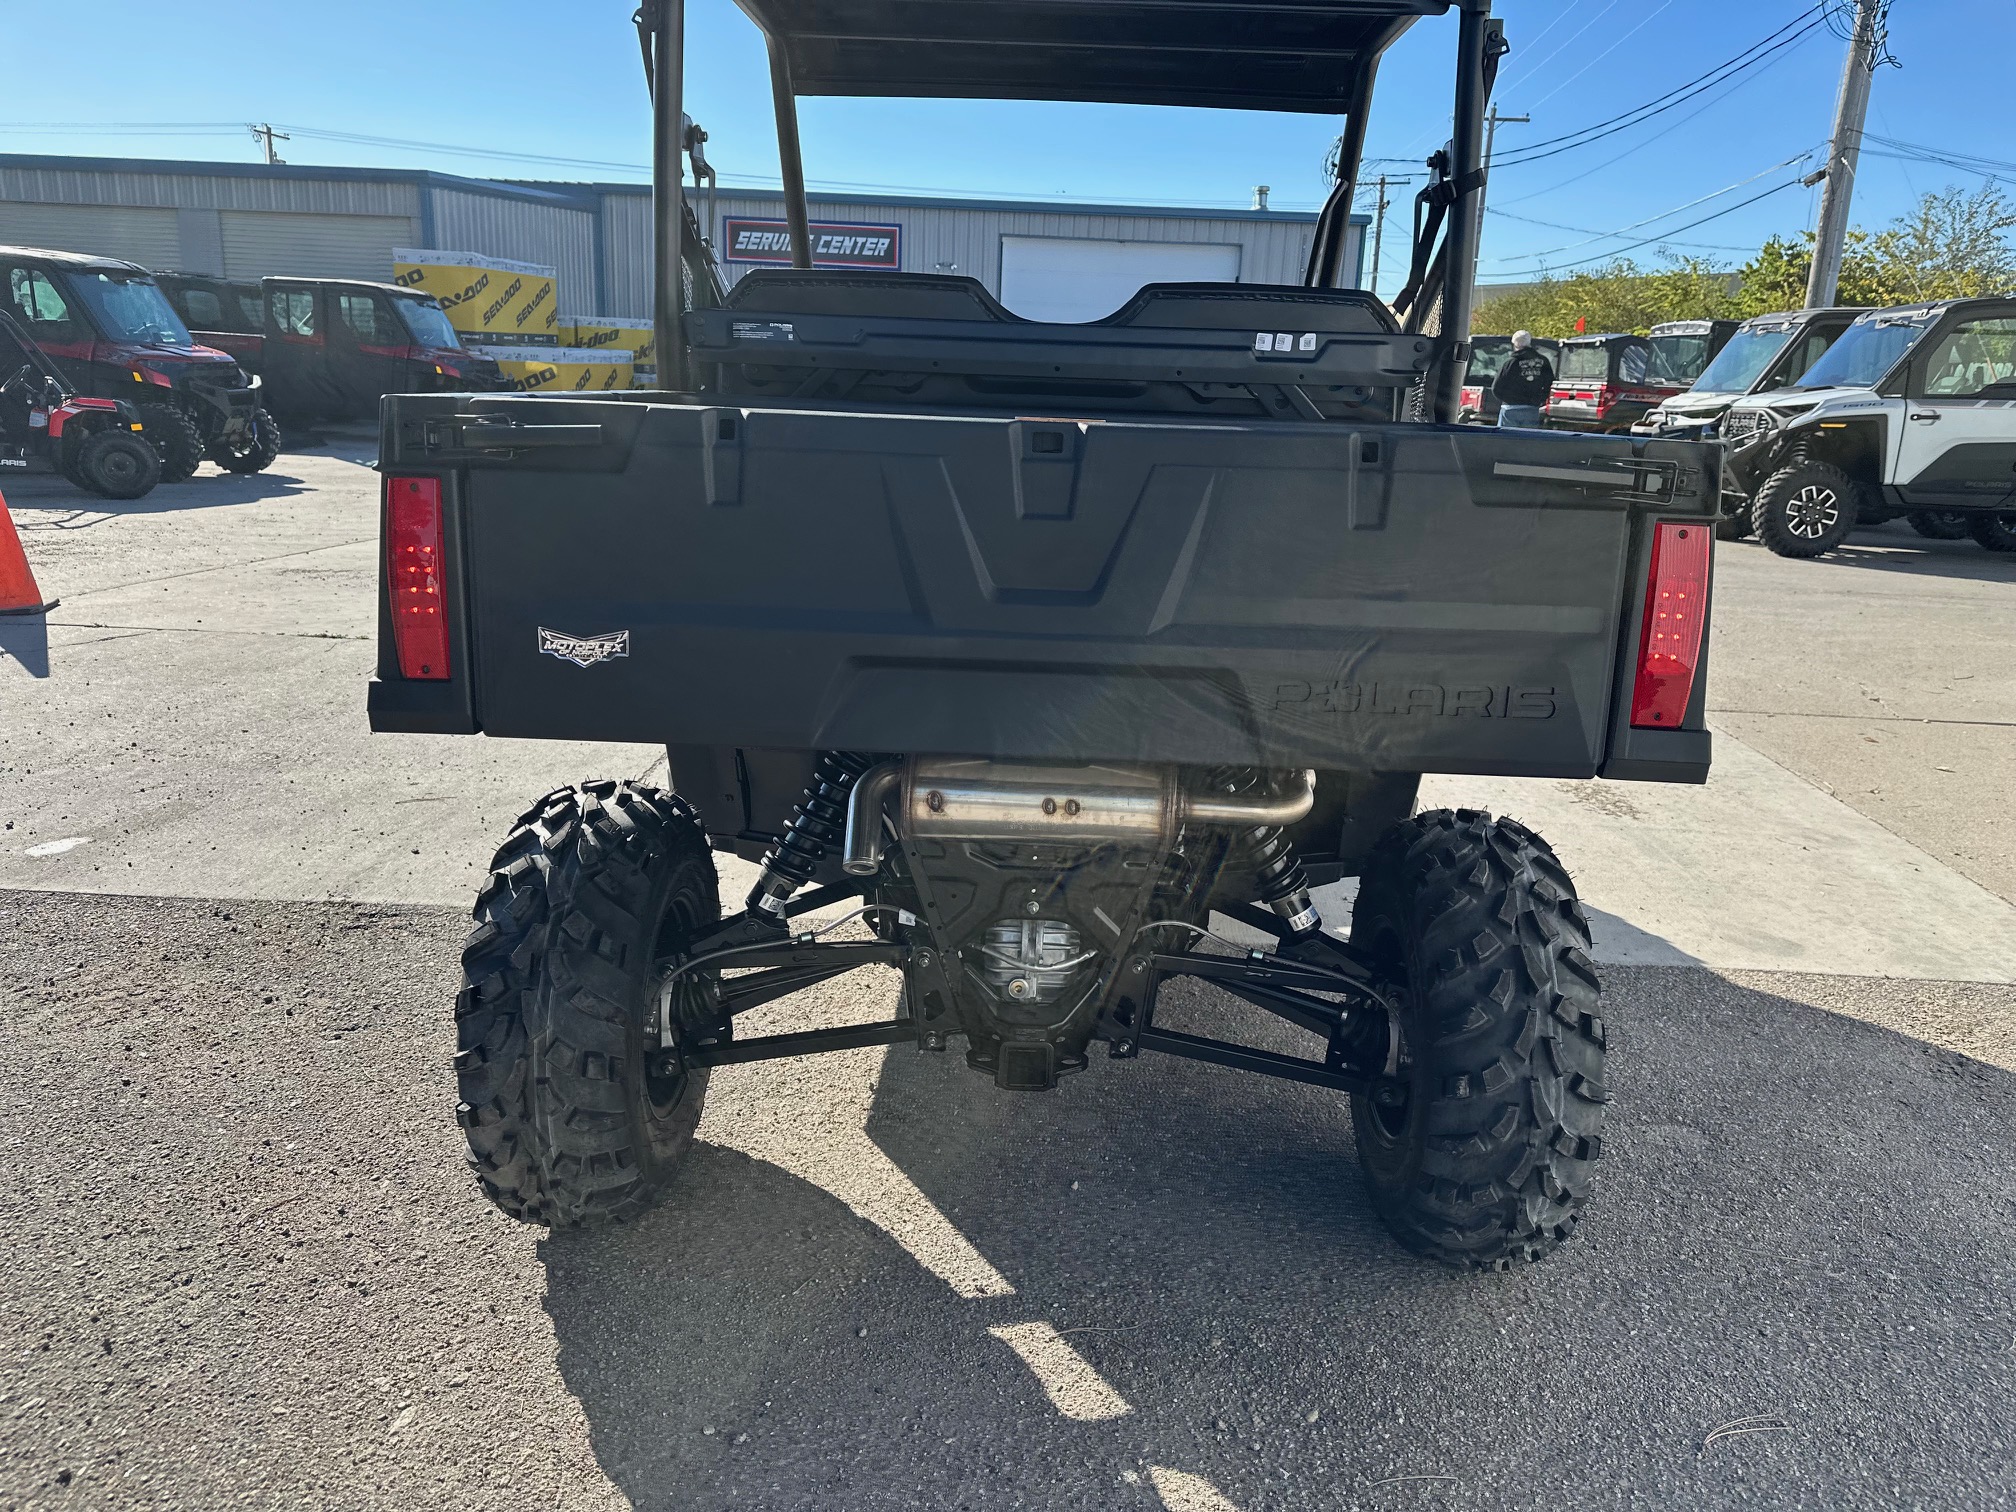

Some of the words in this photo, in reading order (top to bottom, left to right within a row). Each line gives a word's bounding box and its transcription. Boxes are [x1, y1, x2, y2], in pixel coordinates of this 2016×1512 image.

[735, 231, 815, 252] SERVI
[816, 235, 891, 256] CENTER
[0, 459, 27, 467] ARIS
[543, 640, 624, 652] MOTOPLEX
[1268, 680, 1557, 720] POLARIS
